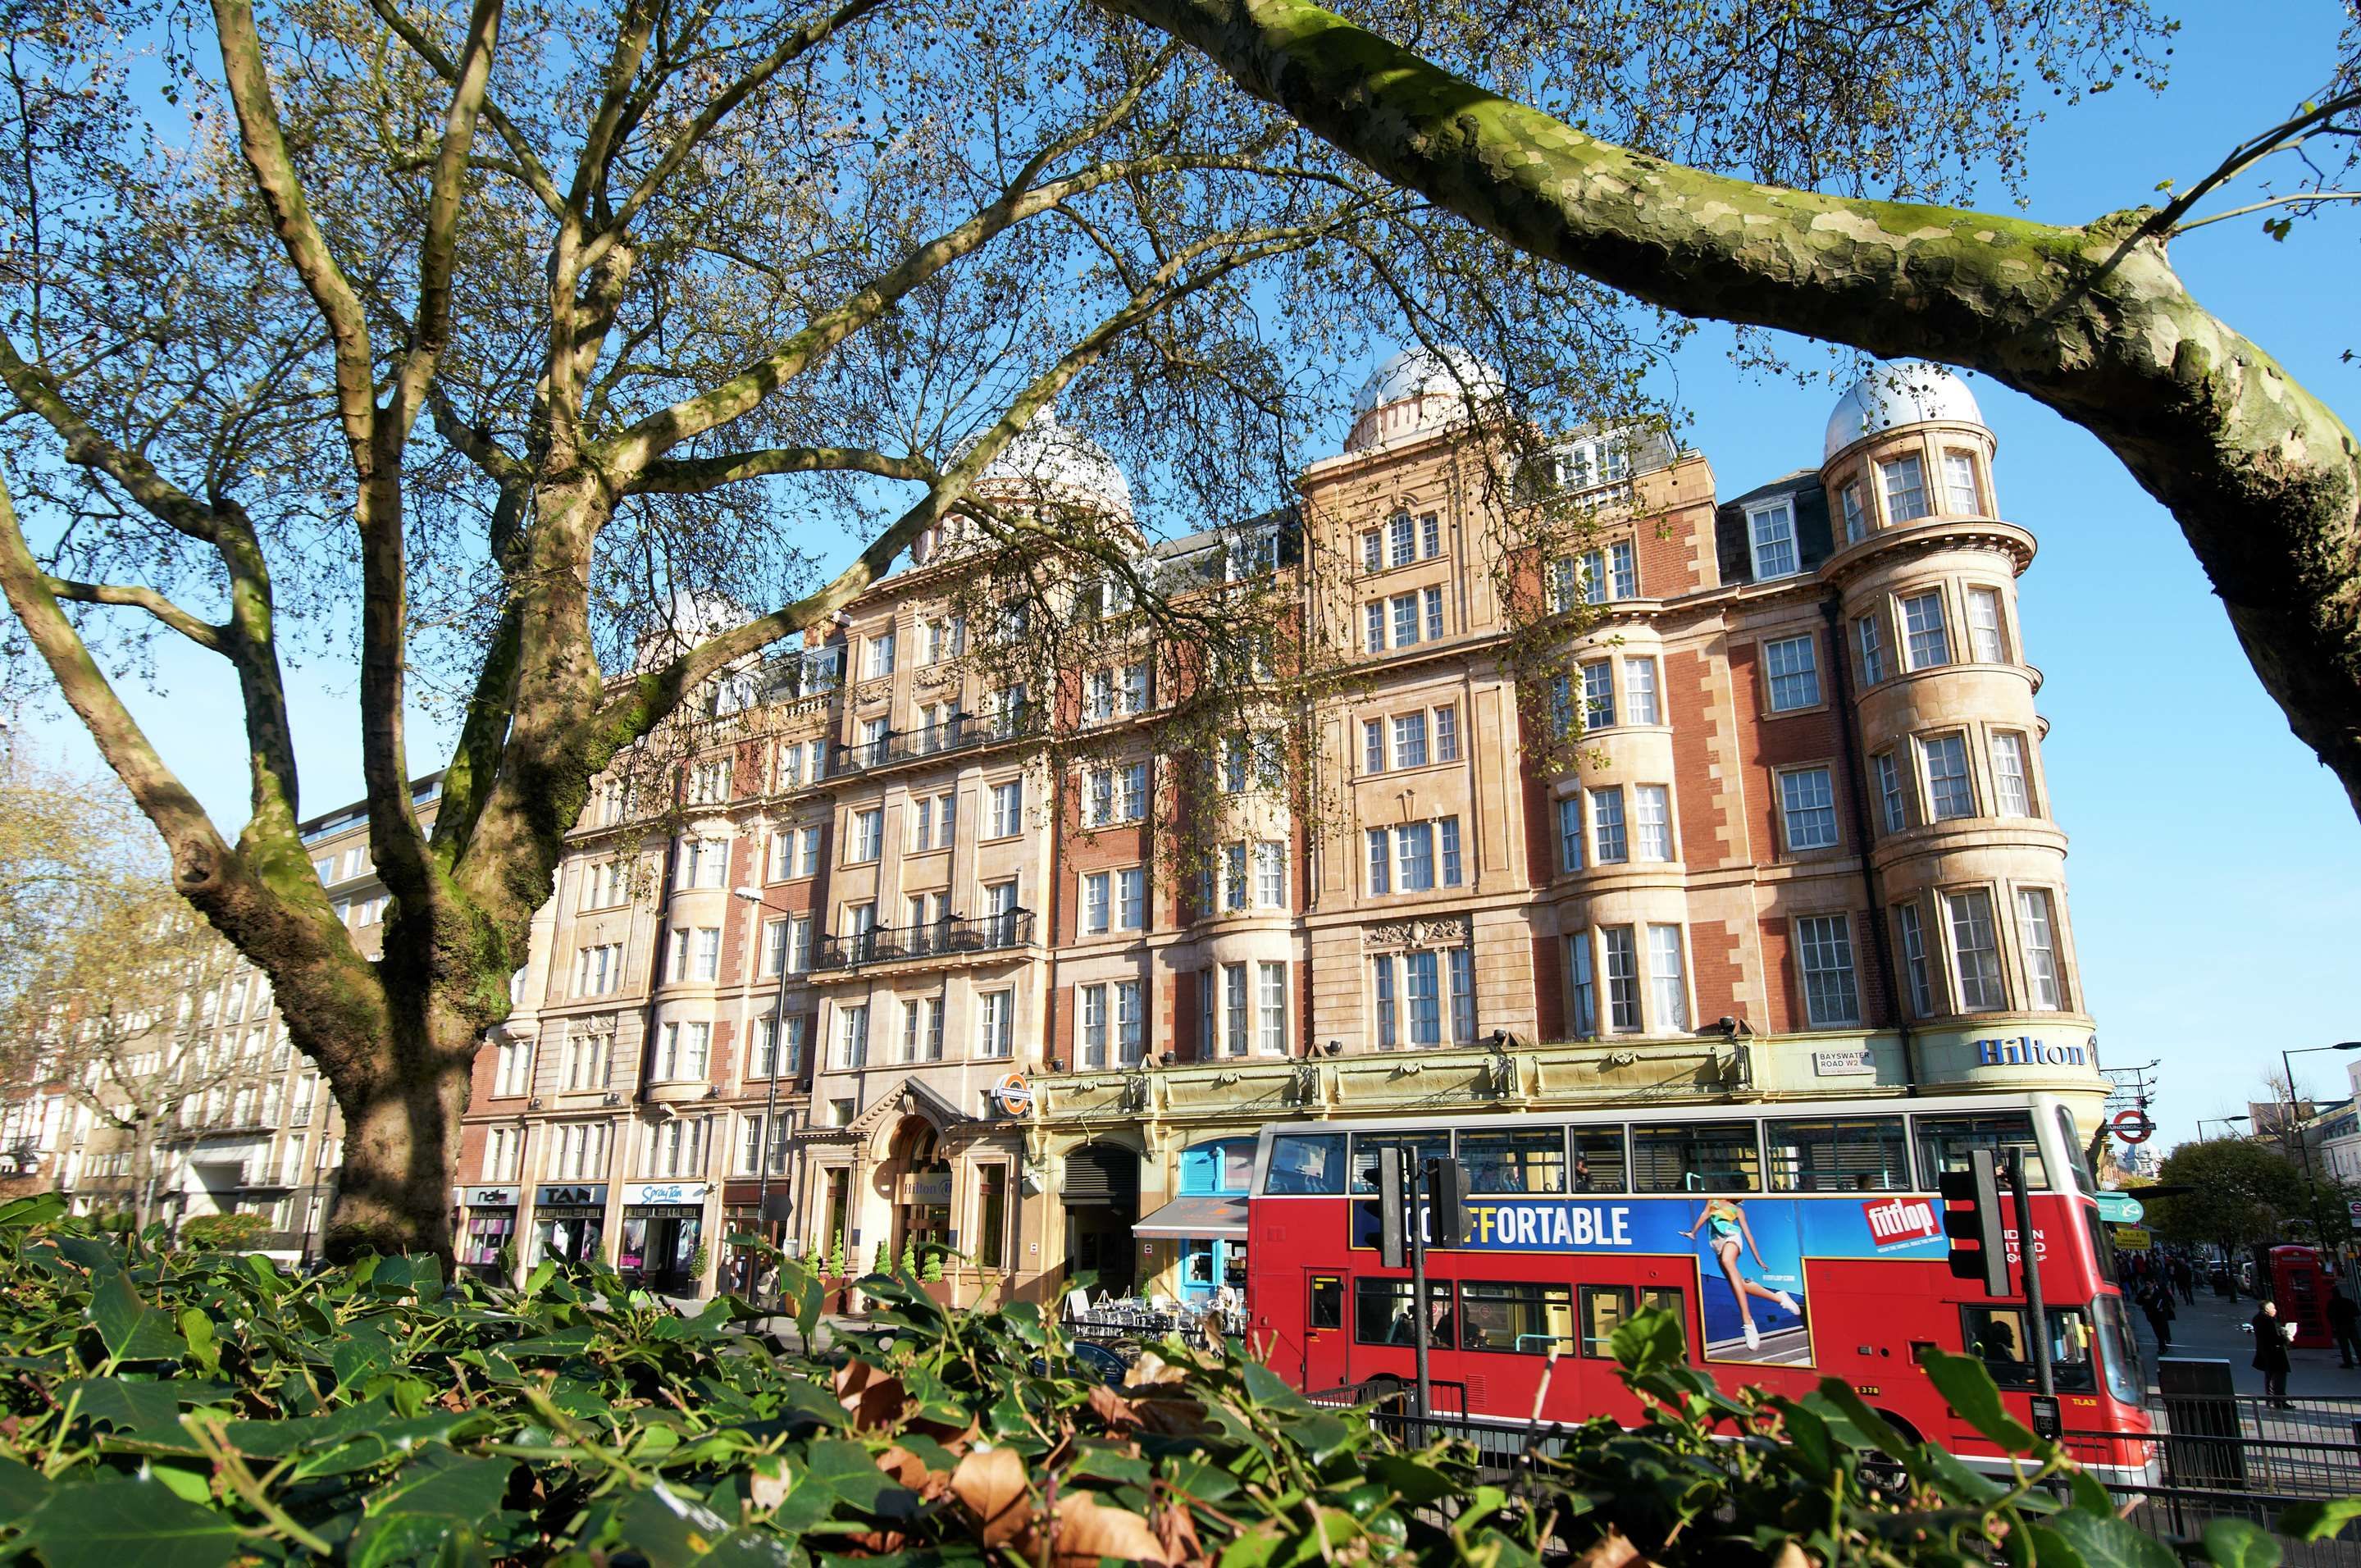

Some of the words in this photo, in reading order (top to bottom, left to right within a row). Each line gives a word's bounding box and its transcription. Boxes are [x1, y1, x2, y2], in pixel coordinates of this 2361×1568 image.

[1820, 1051, 1870, 1060] BAYSWATER
[1976, 1036, 2086, 1065] Hilton
[2109, 1123, 2155, 1131] UNDERGROND
[641, 1185, 669, 1205] Spray
[668, 1185, 683, 1198] Tan
[904, 1181, 938, 1195] Hilton
[1405, 1206, 1632, 1246] OFORTABLE
[1868, 1198, 1935, 1237] fitflop
